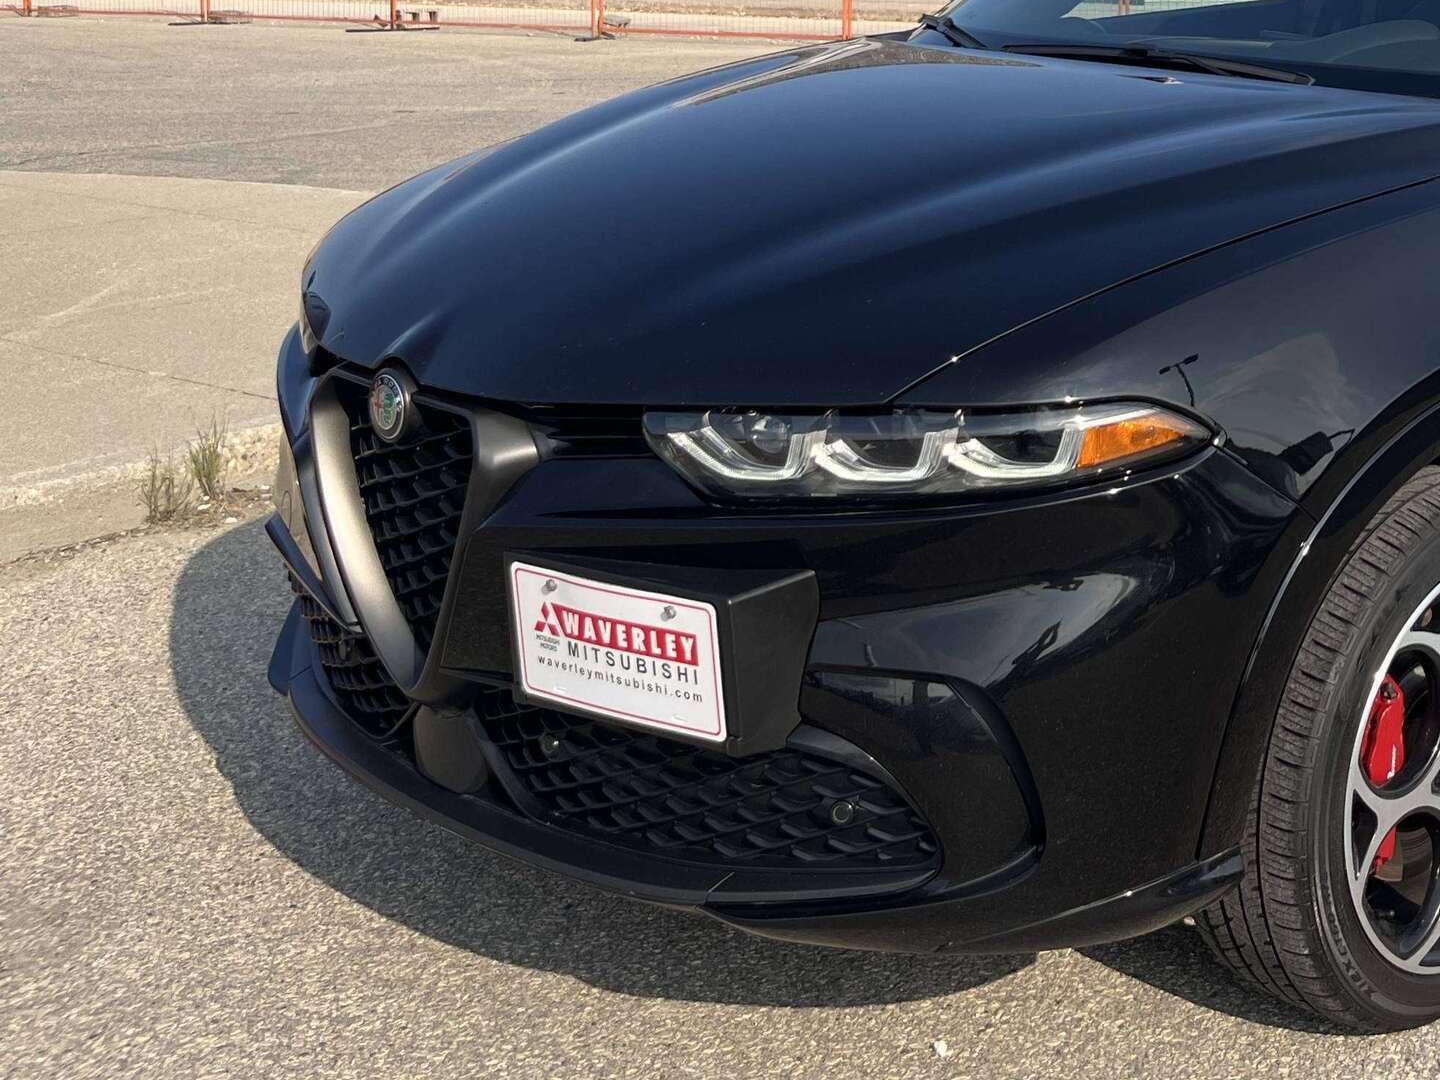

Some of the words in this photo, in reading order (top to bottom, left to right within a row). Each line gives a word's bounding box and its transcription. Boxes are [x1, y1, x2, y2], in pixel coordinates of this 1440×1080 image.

[562, 610, 694, 661] WAVERLEY
[537, 656, 703, 703] waverleymitsubishi.com
[568, 641, 699, 685] MITSUBISHI
